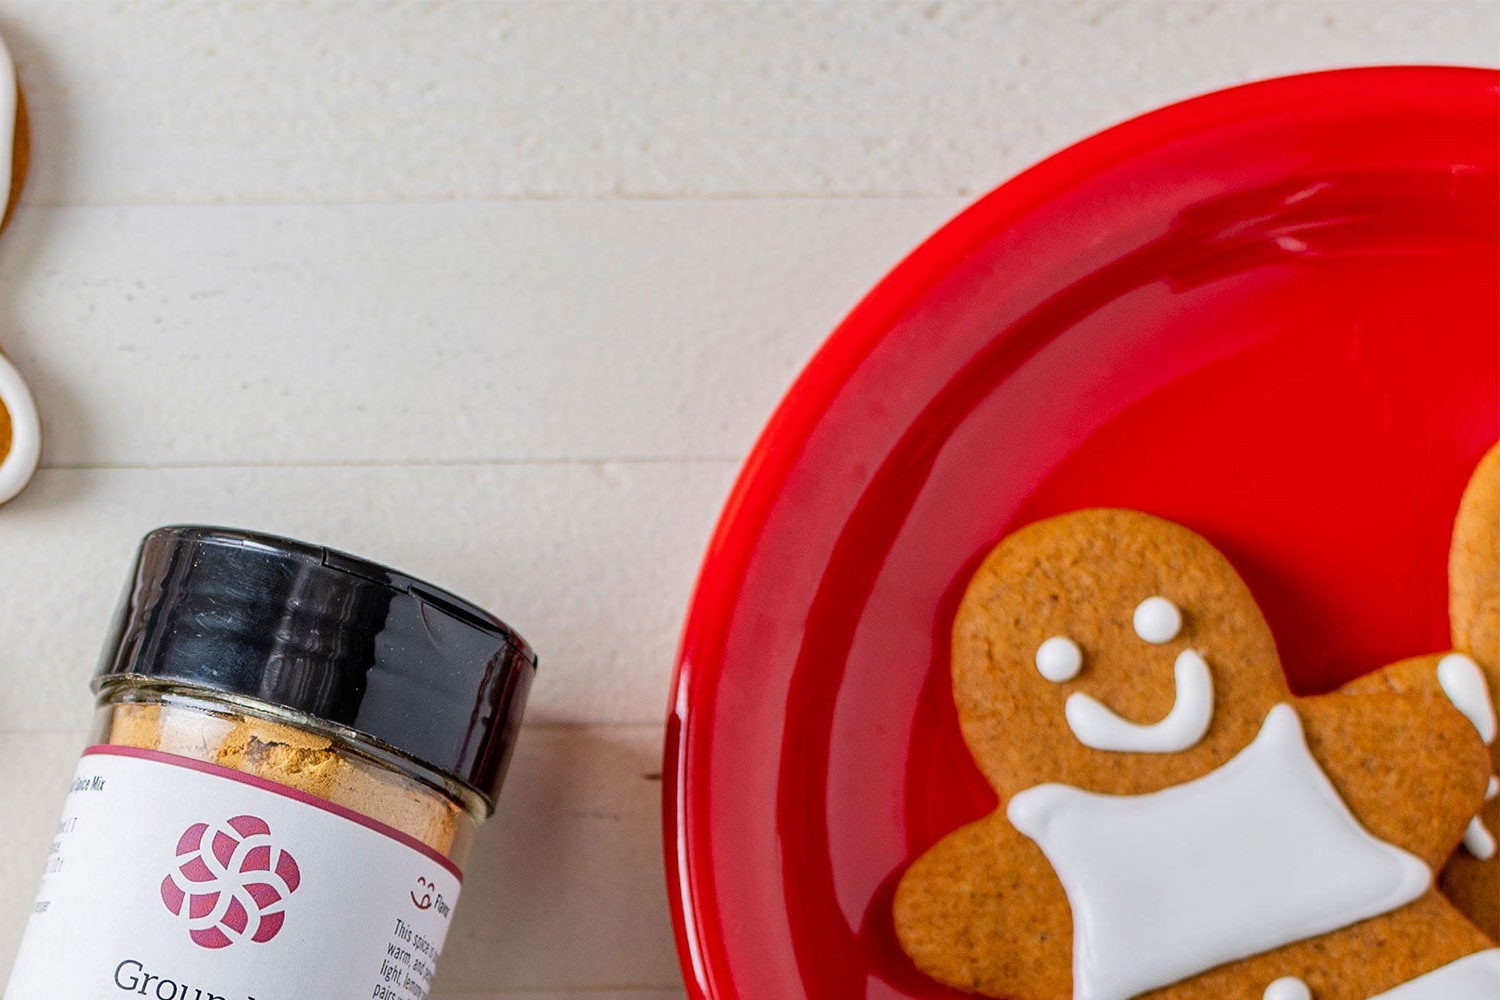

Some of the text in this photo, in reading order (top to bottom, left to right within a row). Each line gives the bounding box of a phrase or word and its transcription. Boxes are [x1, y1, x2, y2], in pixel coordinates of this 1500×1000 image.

[91, 776, 106, 792] Mix
[394, 918, 412, 942] This
[412, 934, 430, 954] spice
[380, 959, 402, 986] light,
[387, 942, 411, 968] warm,
[412, 959, 426, 976] and
